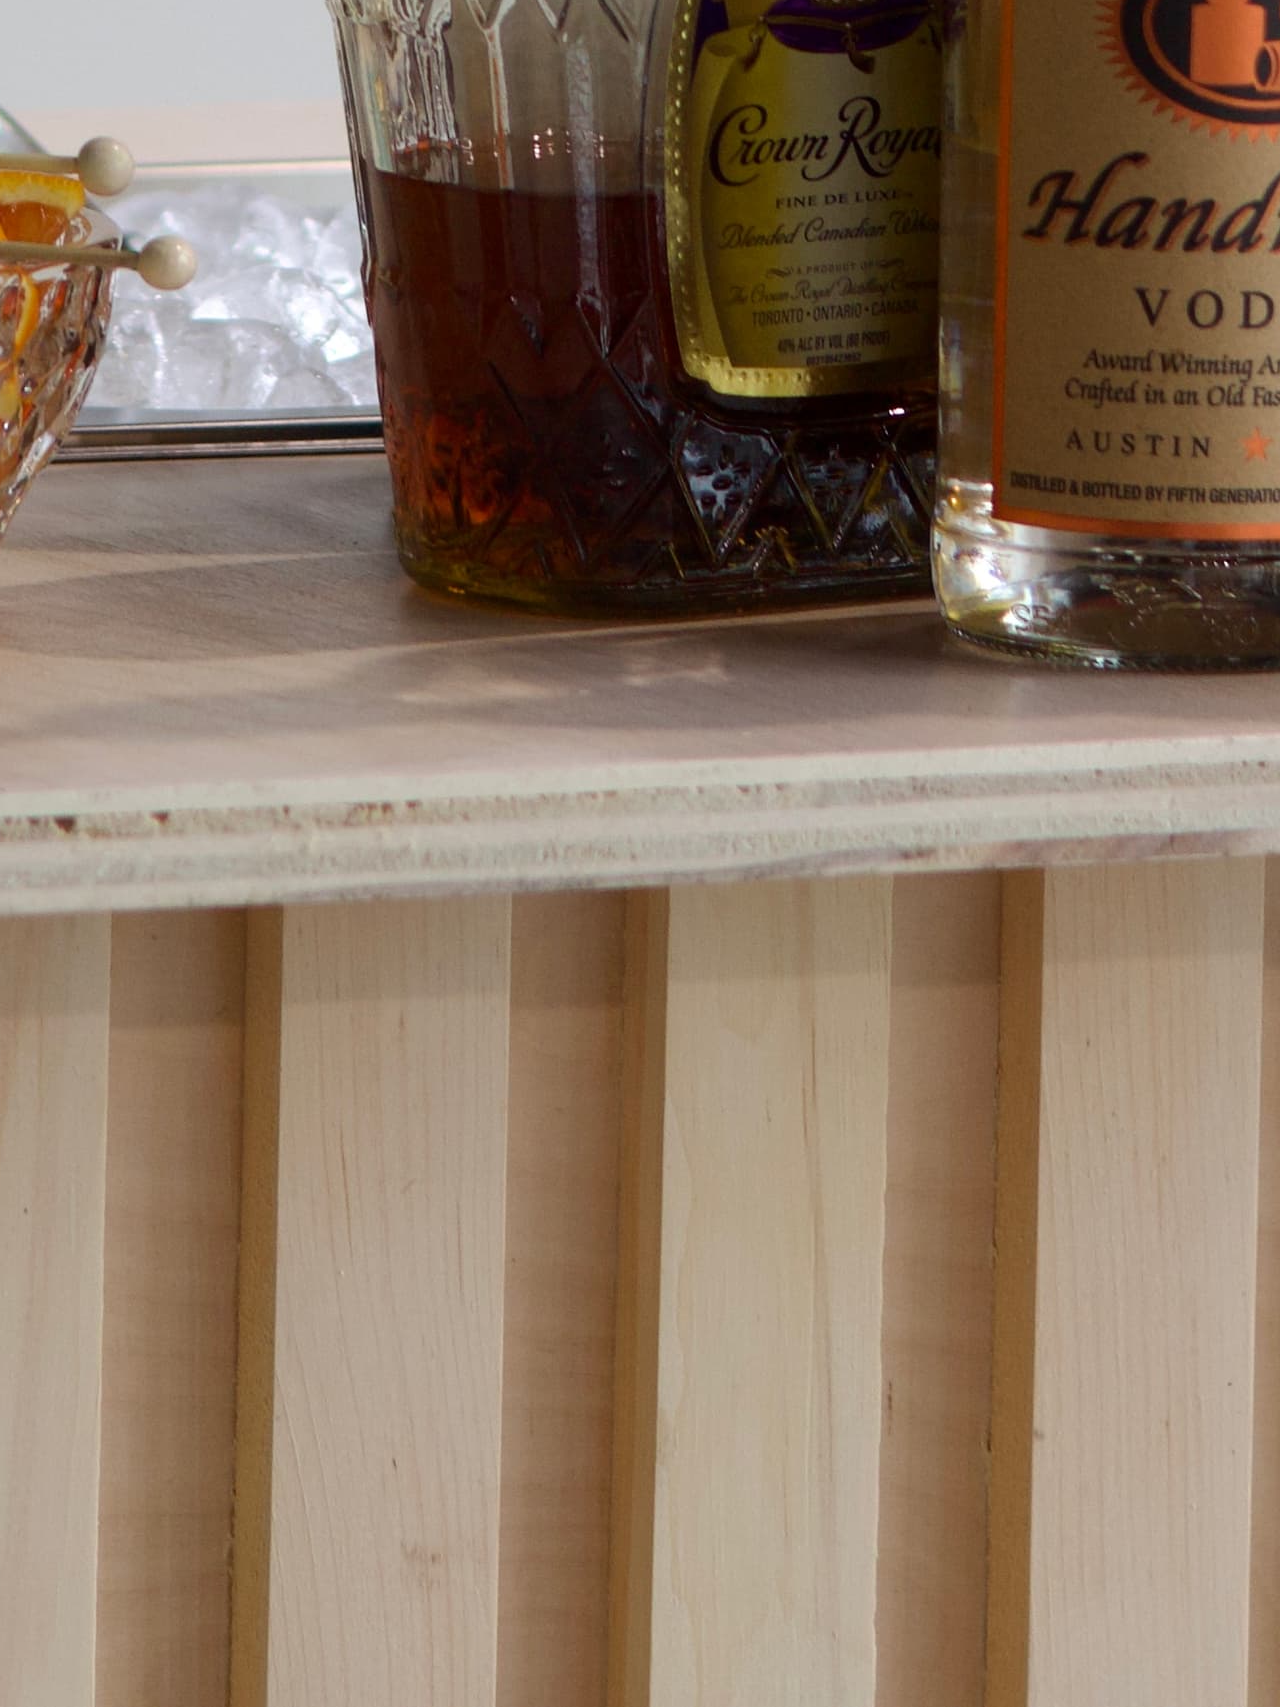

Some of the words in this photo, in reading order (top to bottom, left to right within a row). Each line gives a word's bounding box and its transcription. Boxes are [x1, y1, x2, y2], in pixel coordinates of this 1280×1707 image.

[709, 104, 830, 186] Crown
[776, 193, 818, 209] FINE
[825, 191, 850, 206] DE
[856, 188, 900, 203] LUXE
[719, 221, 805, 249] Blended
[804, 216, 887, 243] Canadian
[806, 262, 856, 275] PRODUCT
[752, 307, 804, 328] TORONTO
[814, 304, 862, 323] ONTARIO
[872, 297, 919, 316] CANADA
[1083, 348, 1153, 374] Award
[1160, 353, 1253, 382] Winning
[1064, 377, 1136, 409] Crafted
[1145, 385, 1166, 405] in
[1173, 390, 1198, 406] an
[1208, 384, 1246, 408] Old
[1065, 428, 1211, 458] AUSTIN
[1010, 471, 1066, 494] DISTILLED
[1069, 479, 1079, 496] &
[1082, 480, 1141, 501] BOTTLED
[1144, 485, 1164, 502] BY
[1167, 486, 1206, 504] FIFTH
